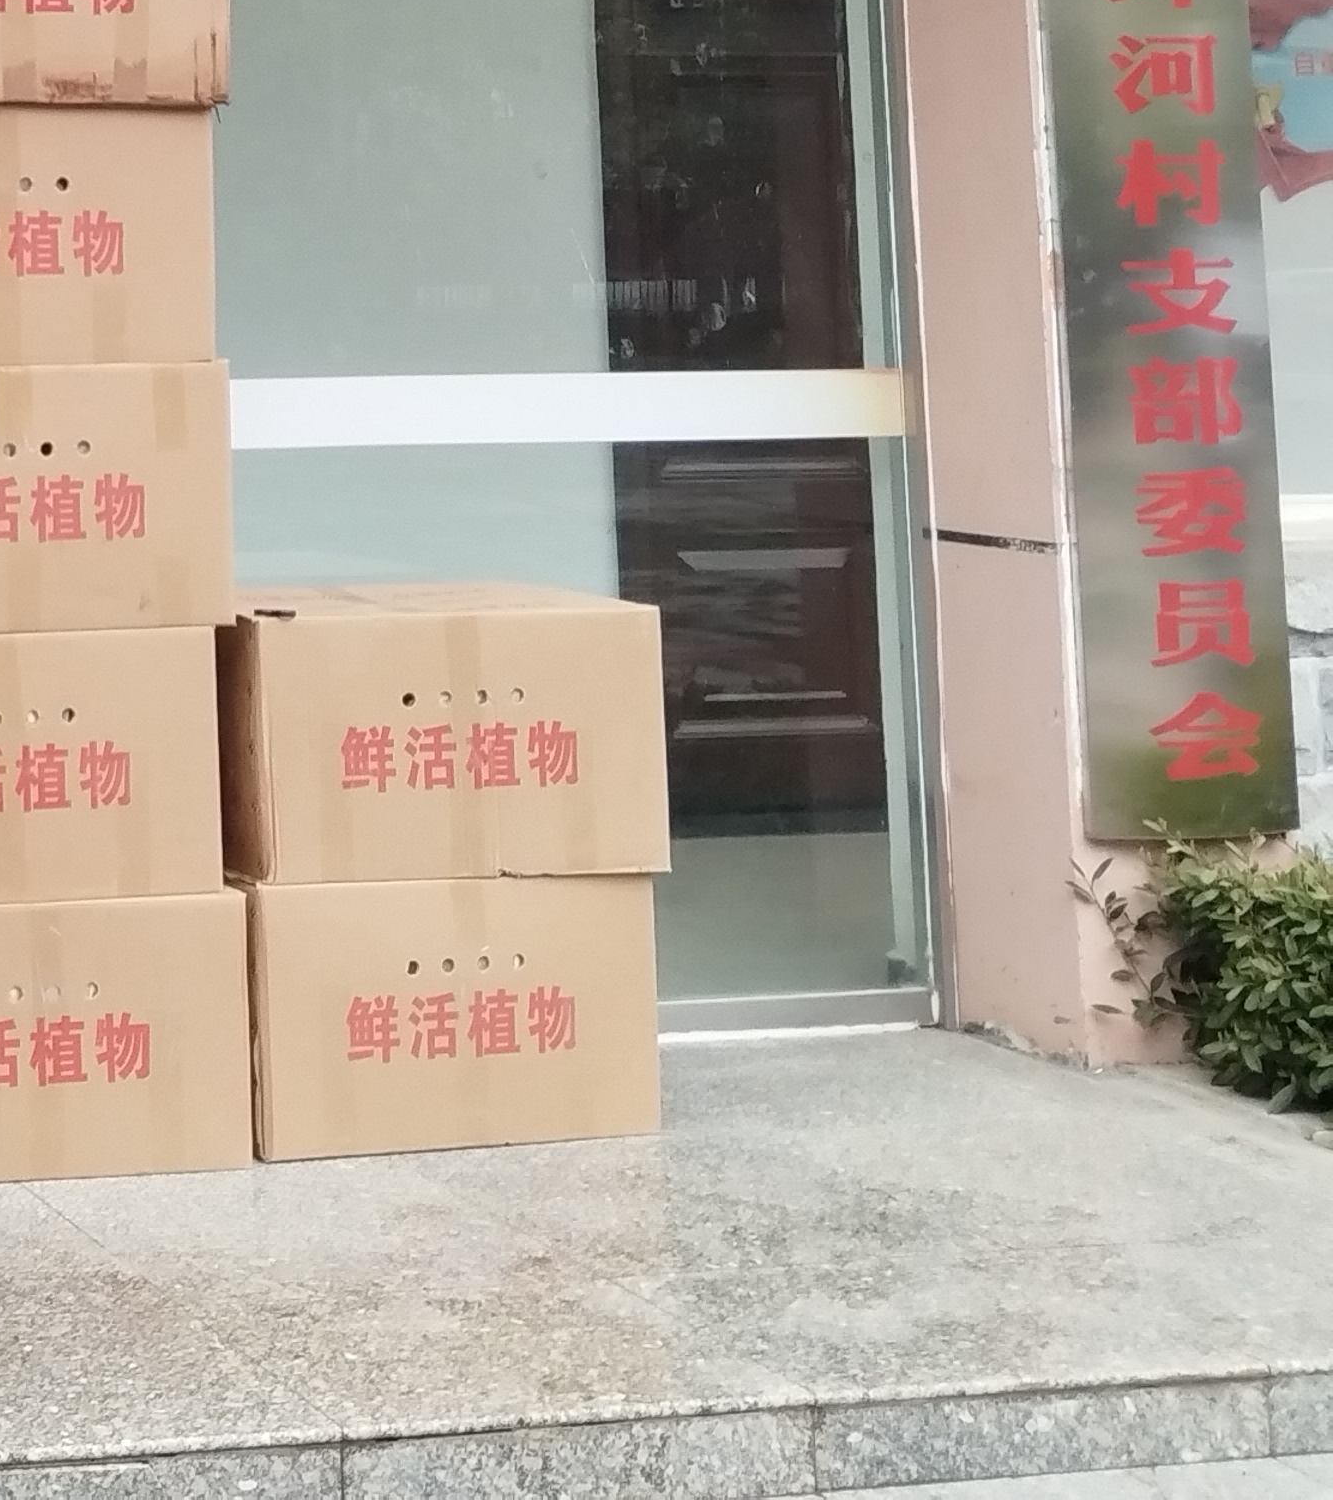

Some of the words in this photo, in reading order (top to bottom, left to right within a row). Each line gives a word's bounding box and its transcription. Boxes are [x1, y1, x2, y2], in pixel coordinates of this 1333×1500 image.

[340, 720, 580, 793] 鲜活植物
[345, 985, 577, 1065] 鲜活植物
